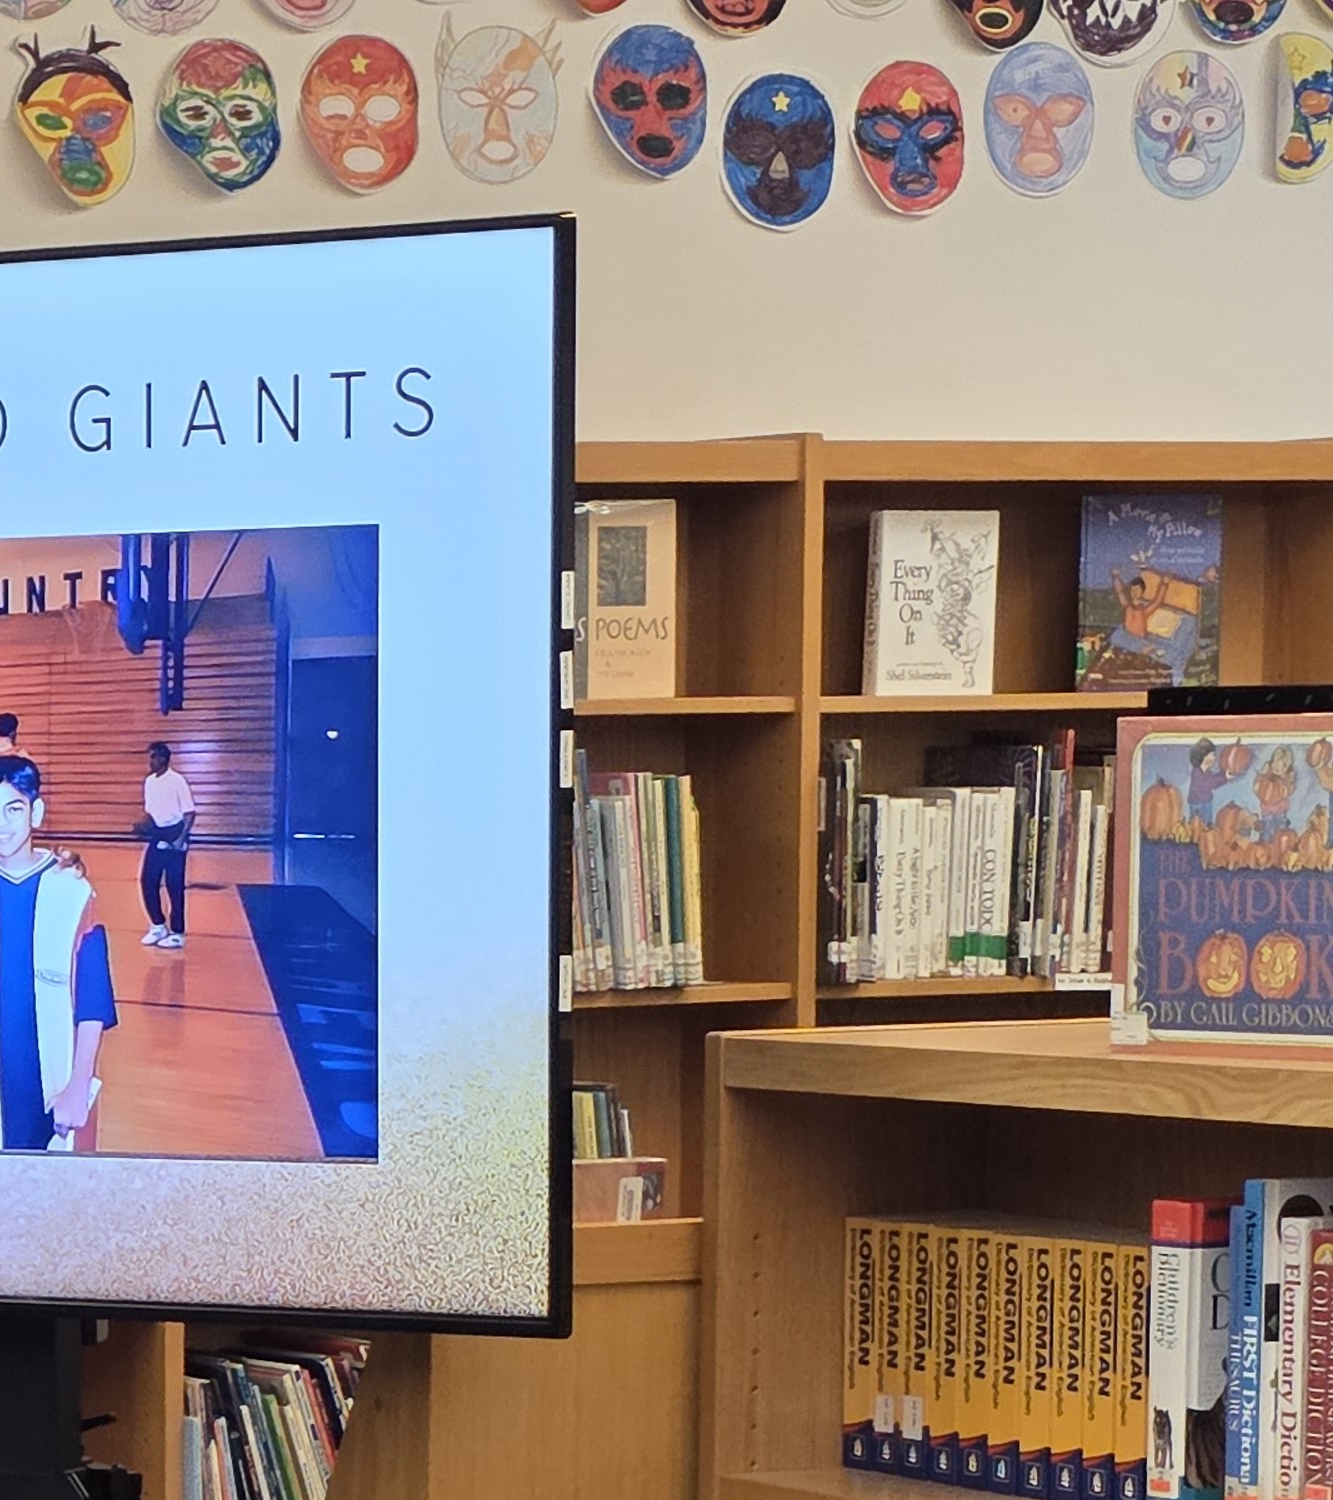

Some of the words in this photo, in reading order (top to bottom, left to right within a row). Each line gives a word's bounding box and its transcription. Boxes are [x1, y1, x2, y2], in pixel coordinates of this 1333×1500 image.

[69, 366, 436, 452] GIANTS
[595, 616, 669, 641] POEMS
[890, 581, 934, 605] Thing
[893, 559, 932, 583] Every
[899, 602, 923, 623] On
[905, 625, 915, 645] It
[1160, 1001, 1183, 1024] BY
[1190, 1001, 1238, 1026] GAIL
[858, 1228, 872, 1366] LONGMAN
[887, 1230, 900, 1368] LONGMAN
[914, 1232, 929, 1371] LONGMAN
[944, 1237, 958, 1377] LONGMAN
[974, 1237, 989, 1379] LONGMAN
[1003, 1242, 1018, 1385] LONGMAN
[1035, 1249, 1049, 1391] LONGMAN
[1067, 1248, 1082, 1392] LONGMAN
[1098, 1252, 1114, 1397] LONGMAN
[1130, 1255, 1144, 1400] LONGMAN
[1281, 1263, 1302, 1404] Elementary
